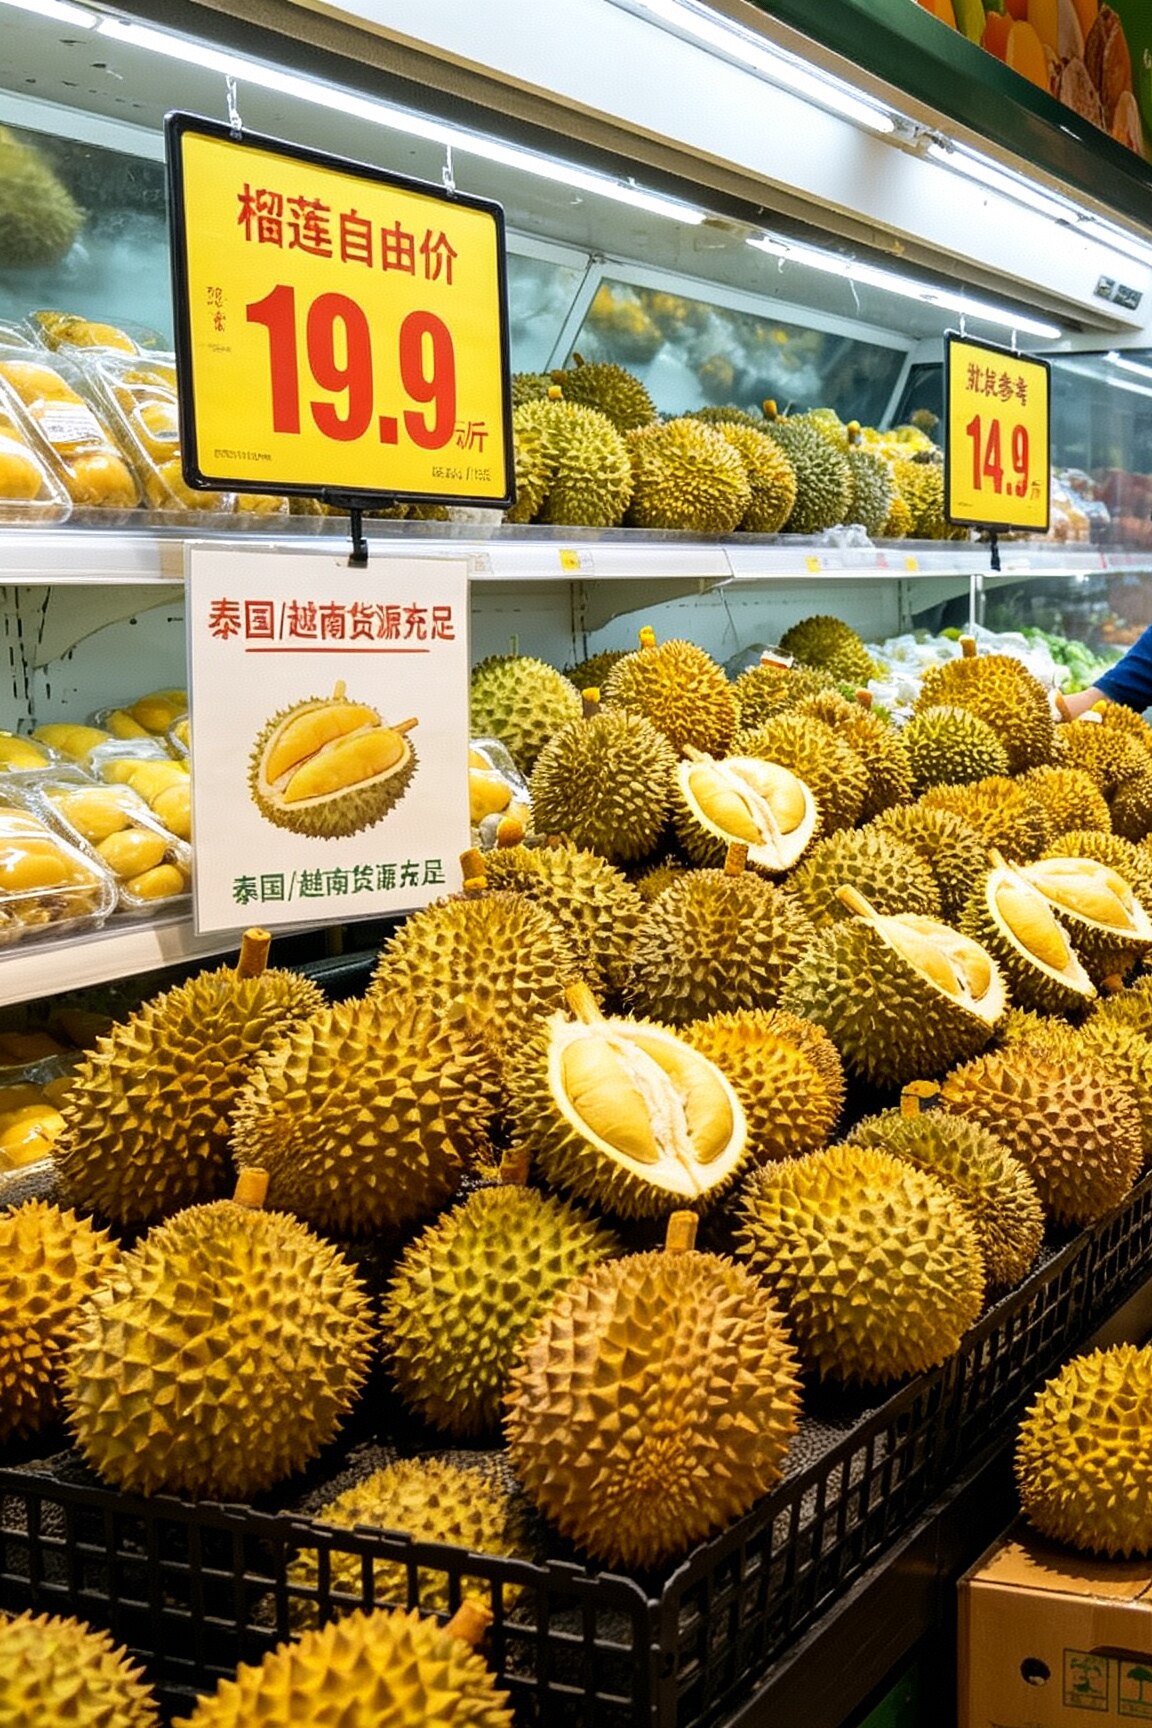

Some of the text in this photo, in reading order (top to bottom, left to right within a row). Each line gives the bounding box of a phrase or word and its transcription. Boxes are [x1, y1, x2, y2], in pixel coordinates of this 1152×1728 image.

[236, 183, 459, 286] 榴莲自由价
[245, 283, 457, 452] 19.9
[966, 413, 1029, 499] 14.9
